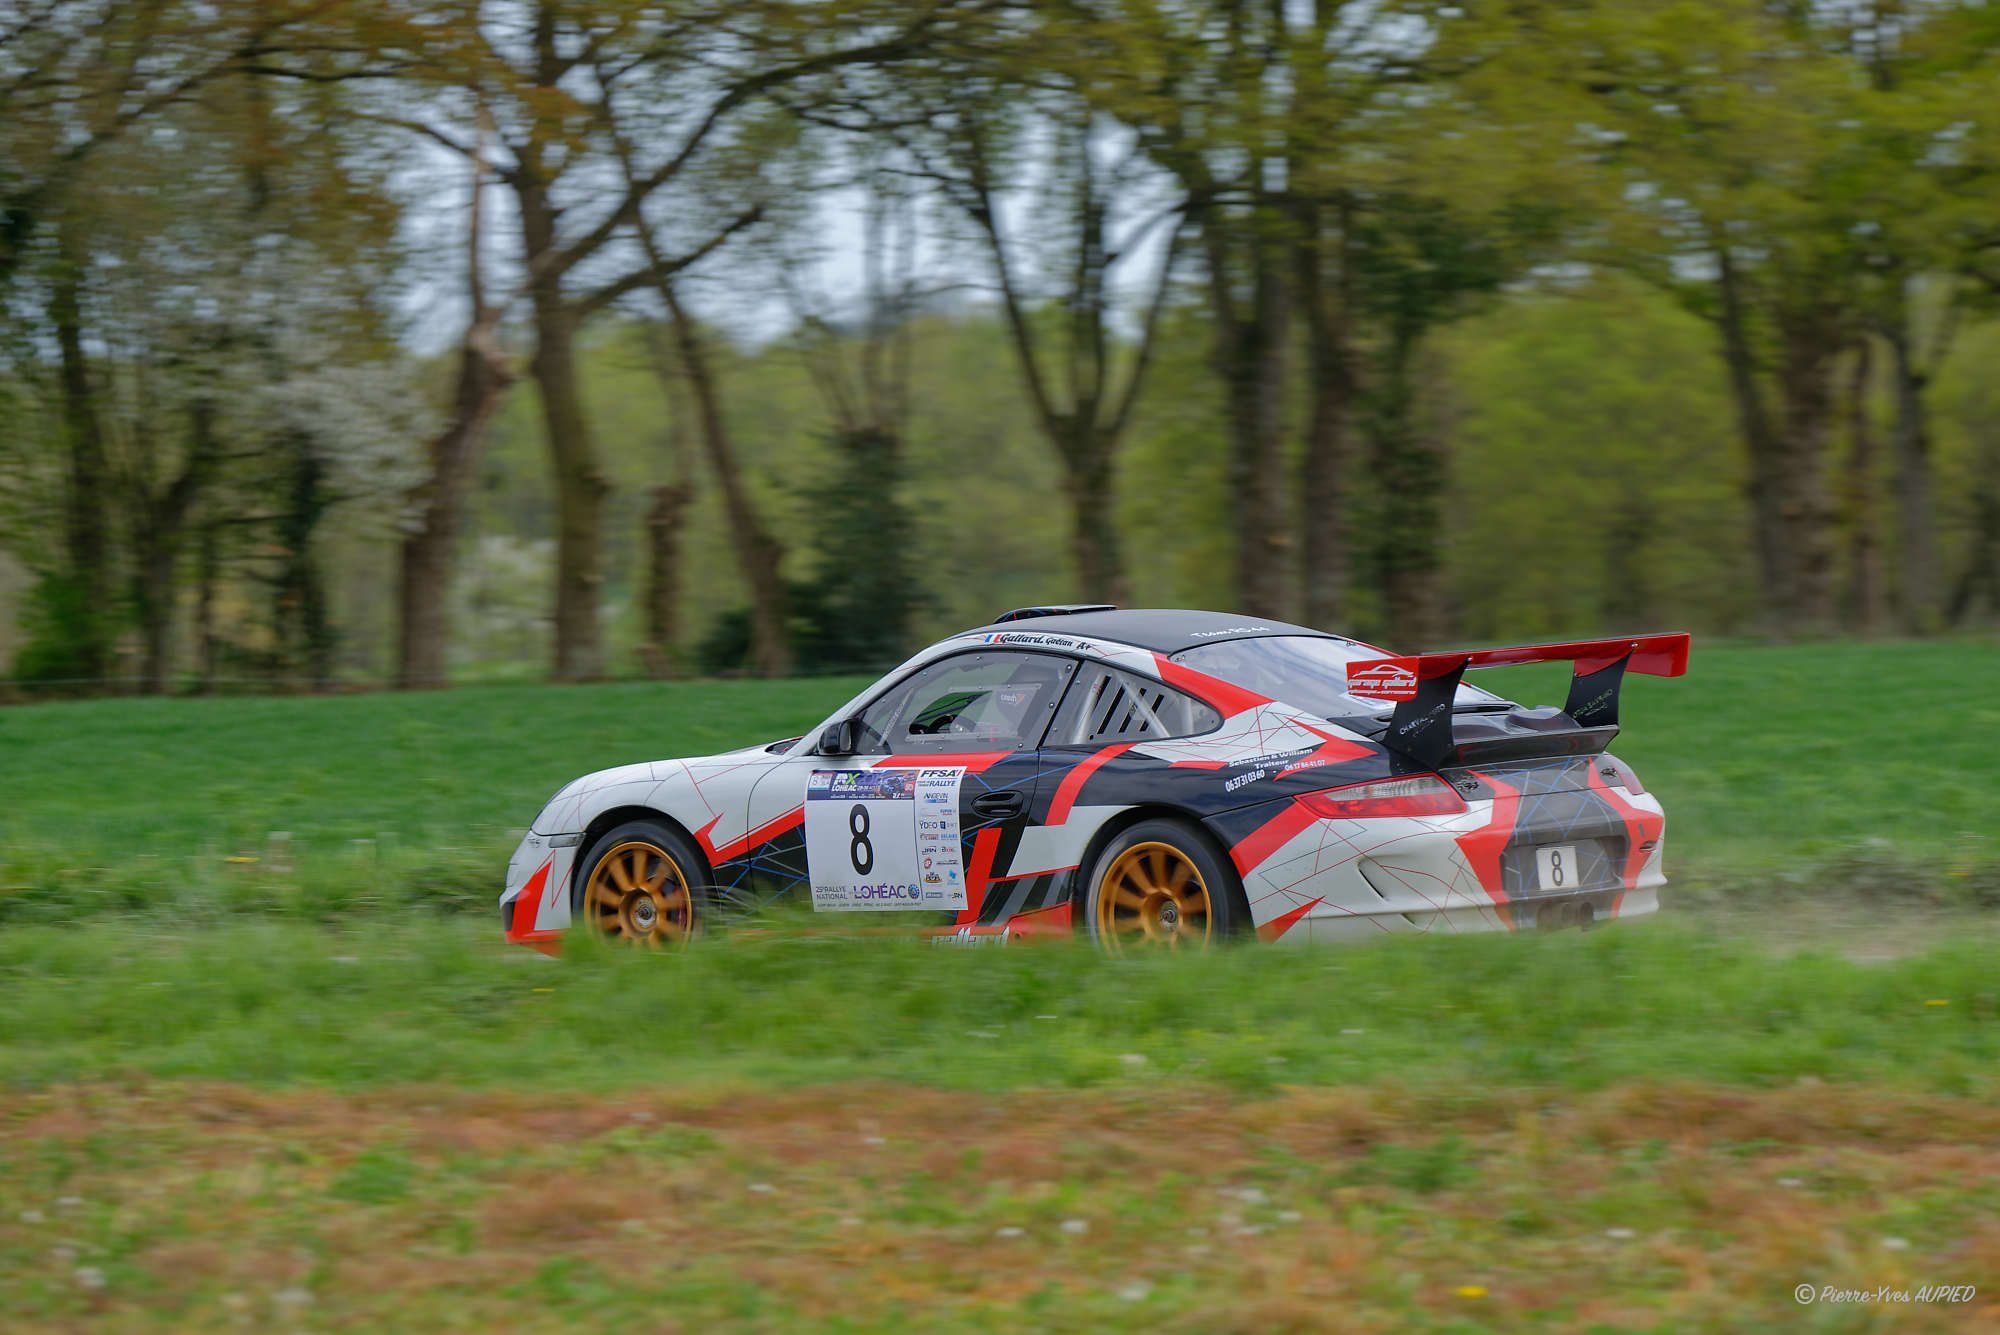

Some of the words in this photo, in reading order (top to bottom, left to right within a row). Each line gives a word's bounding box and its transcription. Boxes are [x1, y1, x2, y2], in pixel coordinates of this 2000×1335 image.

[1279, 748, 1313, 758] William
[1254, 759, 1289, 769] Traiteur
[921, 769, 956, 777] FFSA
[849, 803, 874, 876] 8
[1551, 850, 1564, 886] 8
[853, 882, 907, 899] LOHÉAC
